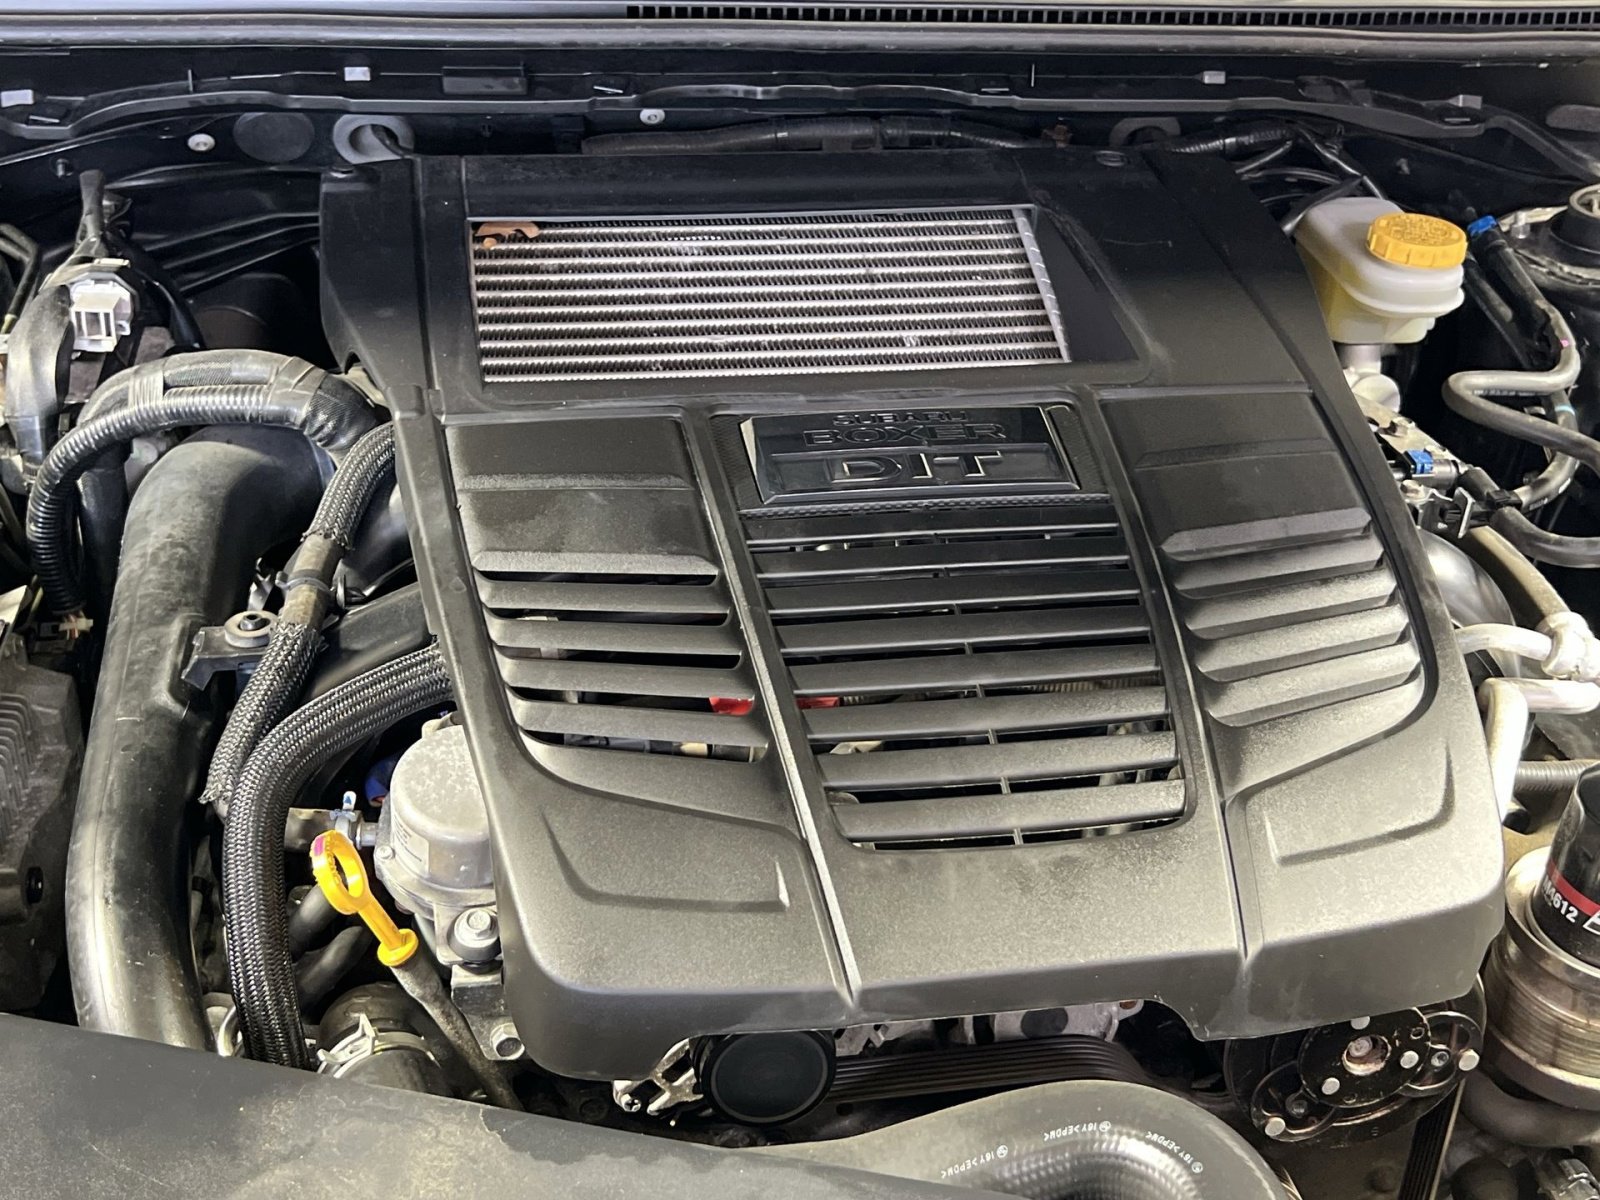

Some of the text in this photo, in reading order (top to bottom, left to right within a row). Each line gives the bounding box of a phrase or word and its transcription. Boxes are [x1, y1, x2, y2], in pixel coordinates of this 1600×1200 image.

[833, 410, 968, 427] SUBARU
[803, 422, 1007, 447] BOXER
[824, 449, 1003, 484] DIT
